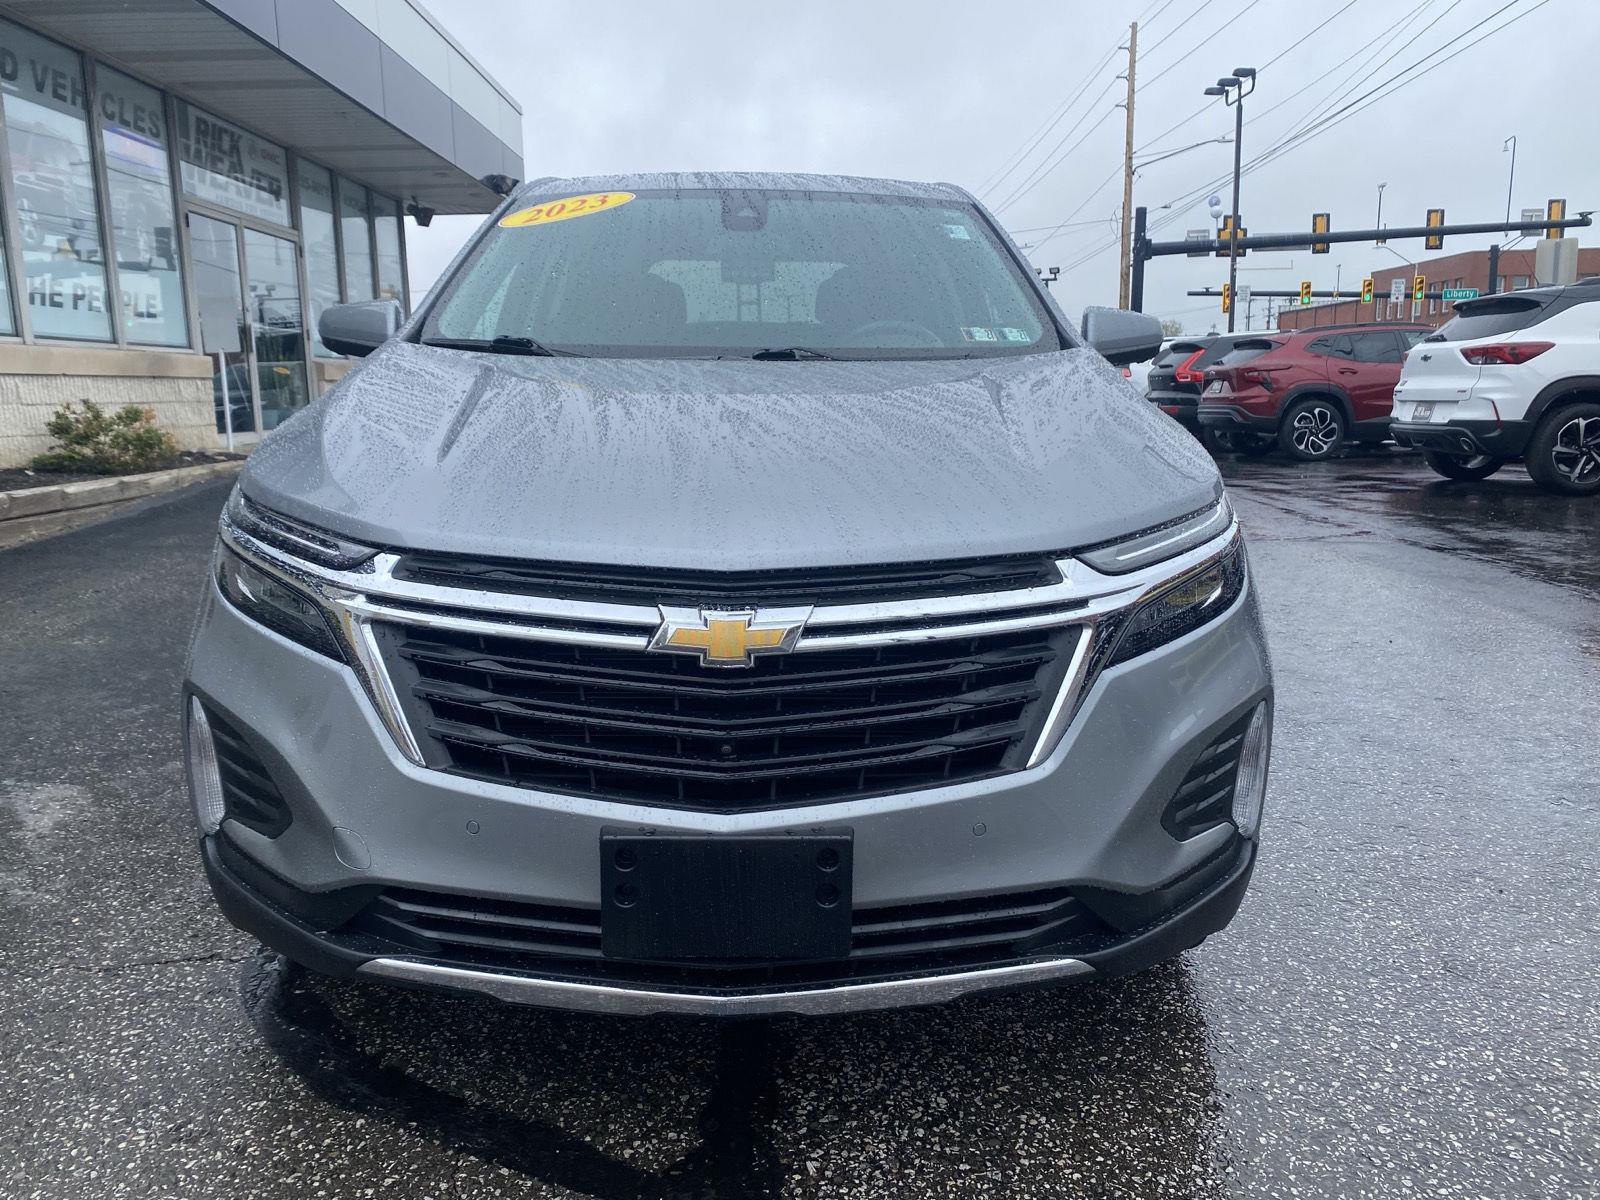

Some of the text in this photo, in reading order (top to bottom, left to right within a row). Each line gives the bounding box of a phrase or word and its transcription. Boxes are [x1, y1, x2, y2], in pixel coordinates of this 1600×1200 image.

[29, 58, 161, 138] VEHCLES
[194, 116, 243, 159] RICK
[522, 195, 608, 224] 2023
[72, 281, 158, 319] PEPLE
[1446, 290, 1475, 299] Liberty
